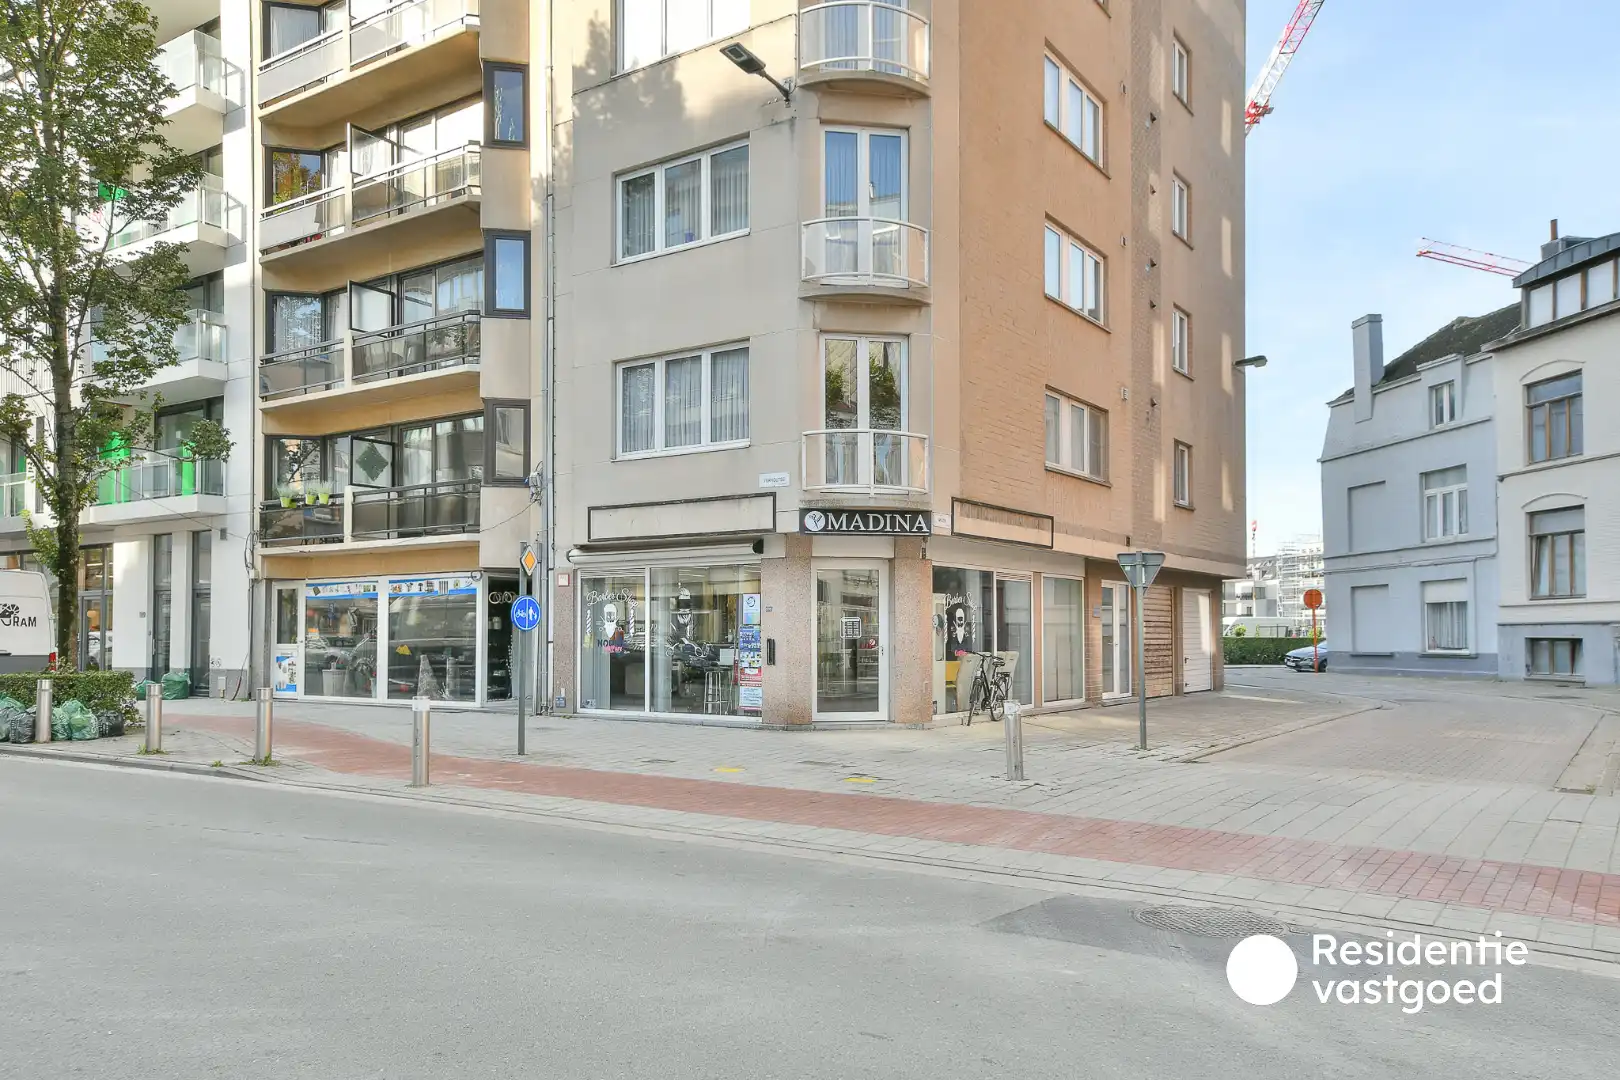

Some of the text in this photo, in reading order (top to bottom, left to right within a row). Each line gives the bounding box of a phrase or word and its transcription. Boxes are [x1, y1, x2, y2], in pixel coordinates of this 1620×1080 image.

[826, 512, 930, 532] MADINA
[586, 588, 639, 610] Barber Shop
